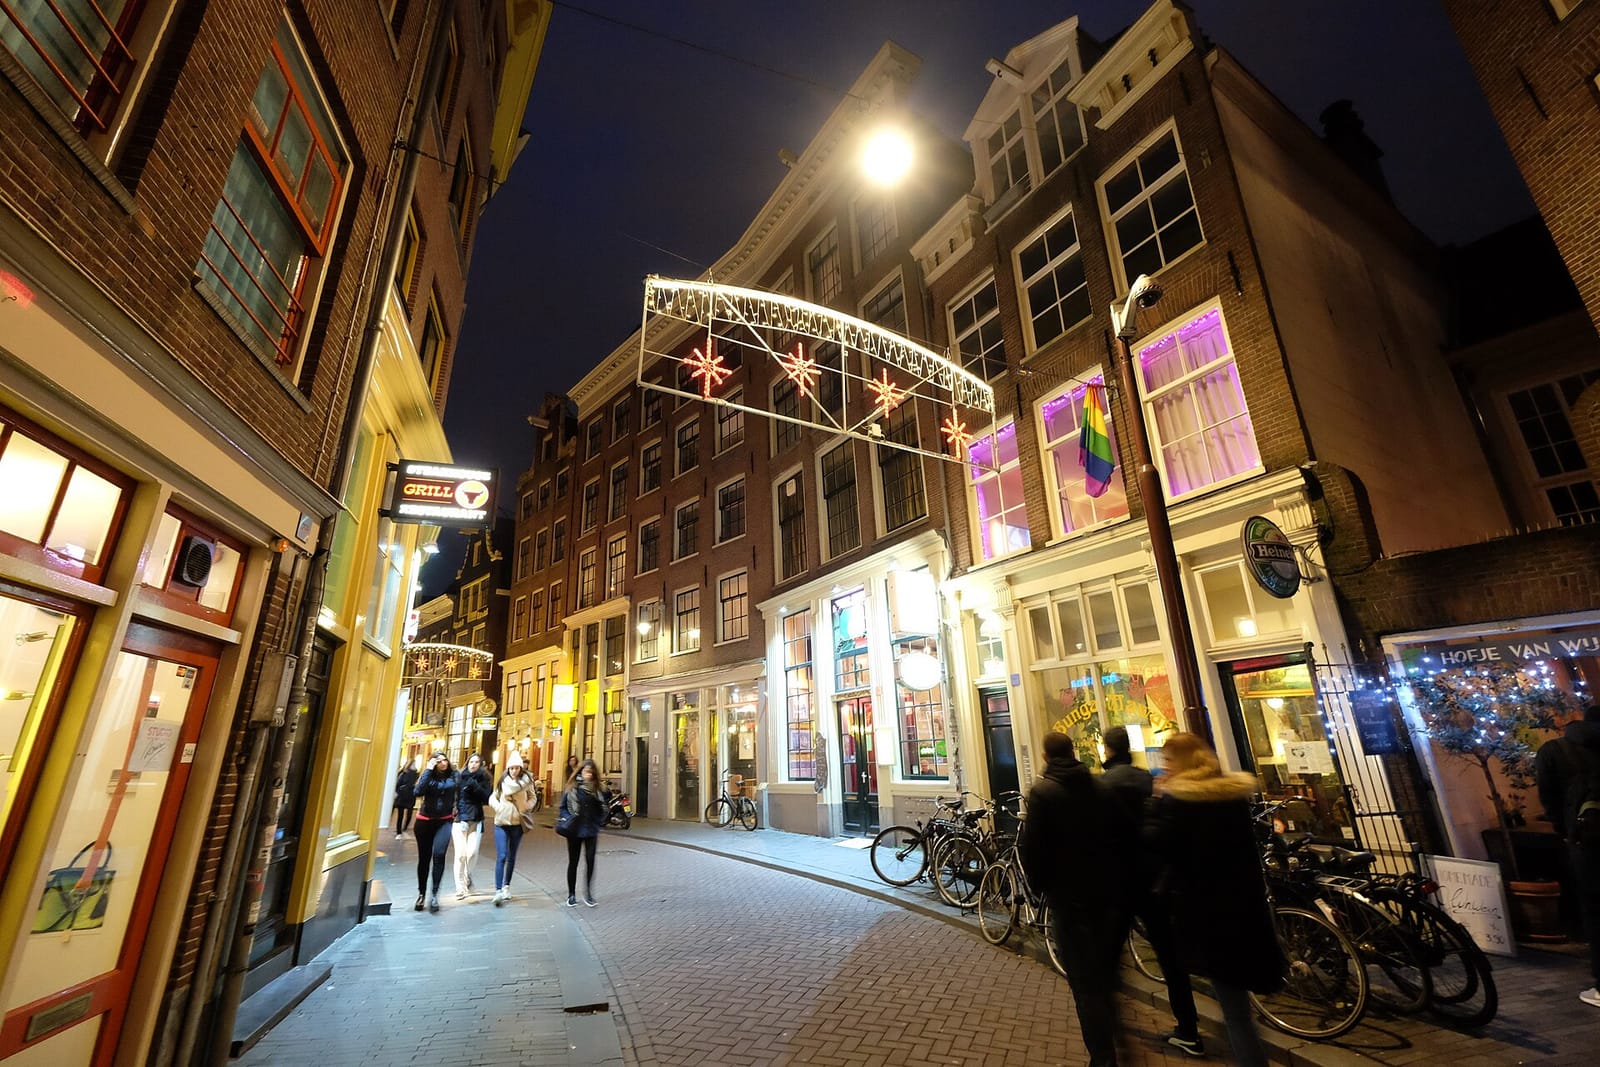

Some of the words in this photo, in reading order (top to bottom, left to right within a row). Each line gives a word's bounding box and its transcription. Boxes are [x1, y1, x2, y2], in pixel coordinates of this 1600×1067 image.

[403, 484, 453, 497] GRILL
[1440, 647, 1501, 665] HOFJE
[1508, 642, 1550, 658] VAN
[1053, 700, 1098, 733] Bunga
